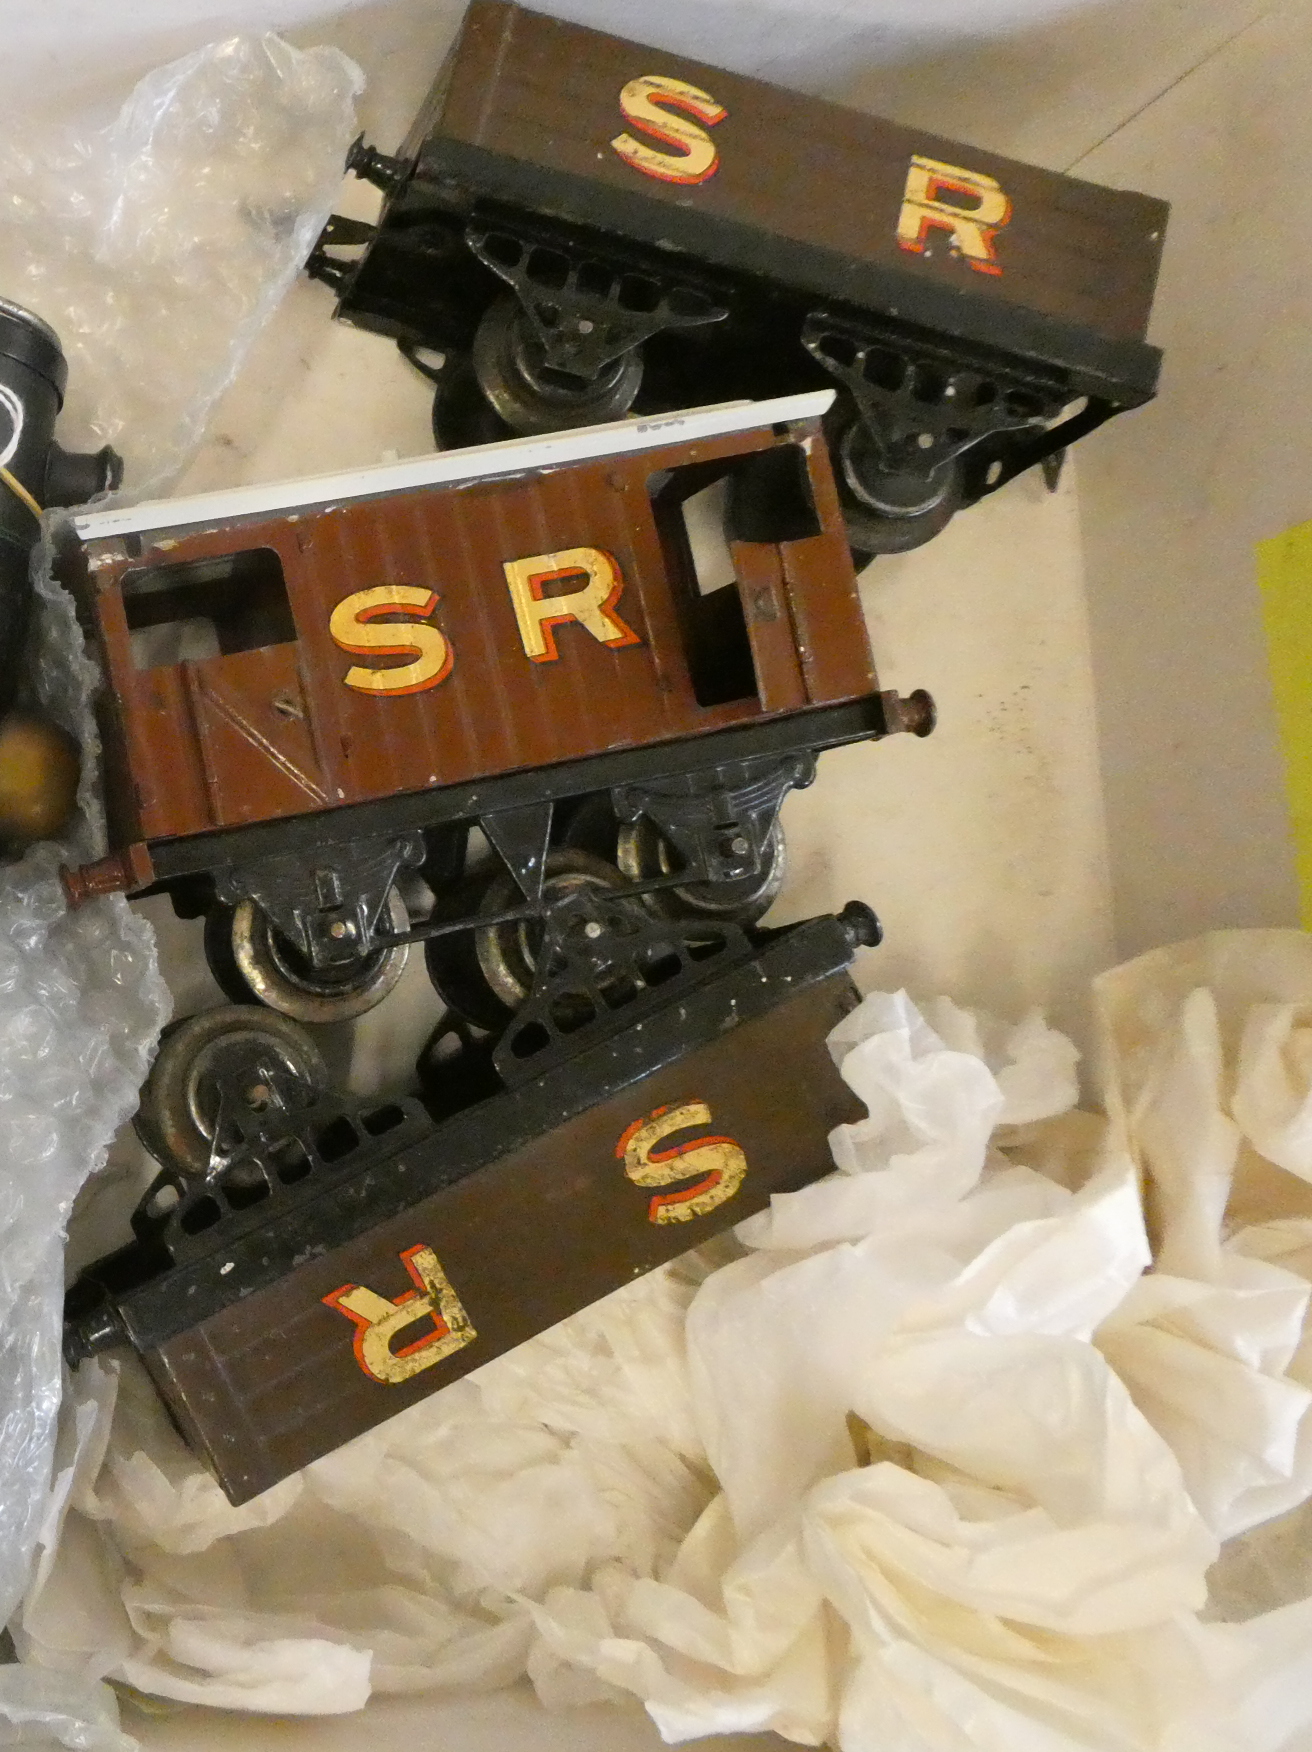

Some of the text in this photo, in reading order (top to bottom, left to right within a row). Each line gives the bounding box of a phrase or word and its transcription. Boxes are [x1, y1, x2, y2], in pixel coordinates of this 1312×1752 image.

[611, 75, 1013, 276] S R
[321, 1099, 748, 1384] S R
